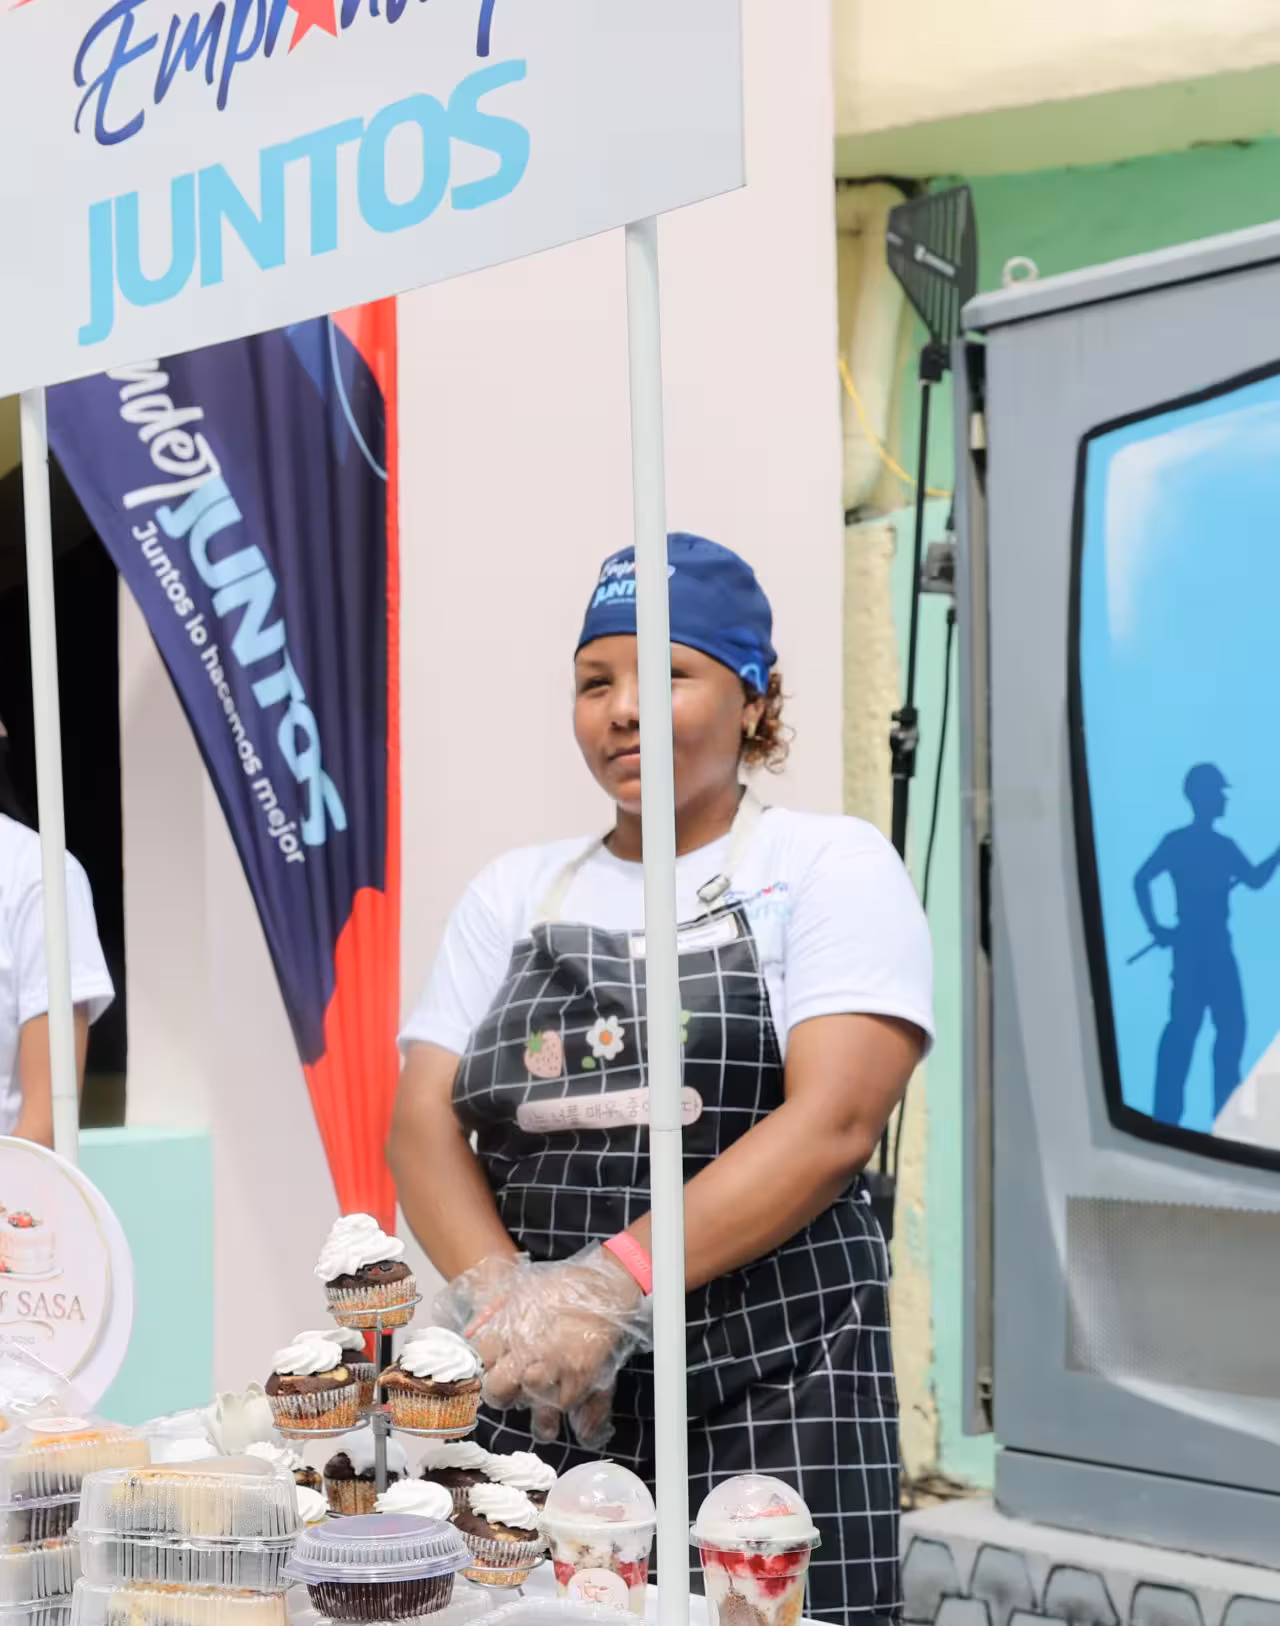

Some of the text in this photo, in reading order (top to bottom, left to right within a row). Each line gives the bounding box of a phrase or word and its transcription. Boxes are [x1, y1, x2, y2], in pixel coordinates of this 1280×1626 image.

[77, 58, 531, 347] JUNTOS
[131, 520, 306, 864] Juntos lo hacemos mejor
[155, 474, 348, 845] JUNTOS
[16, 1289, 86, 1322] SASA
